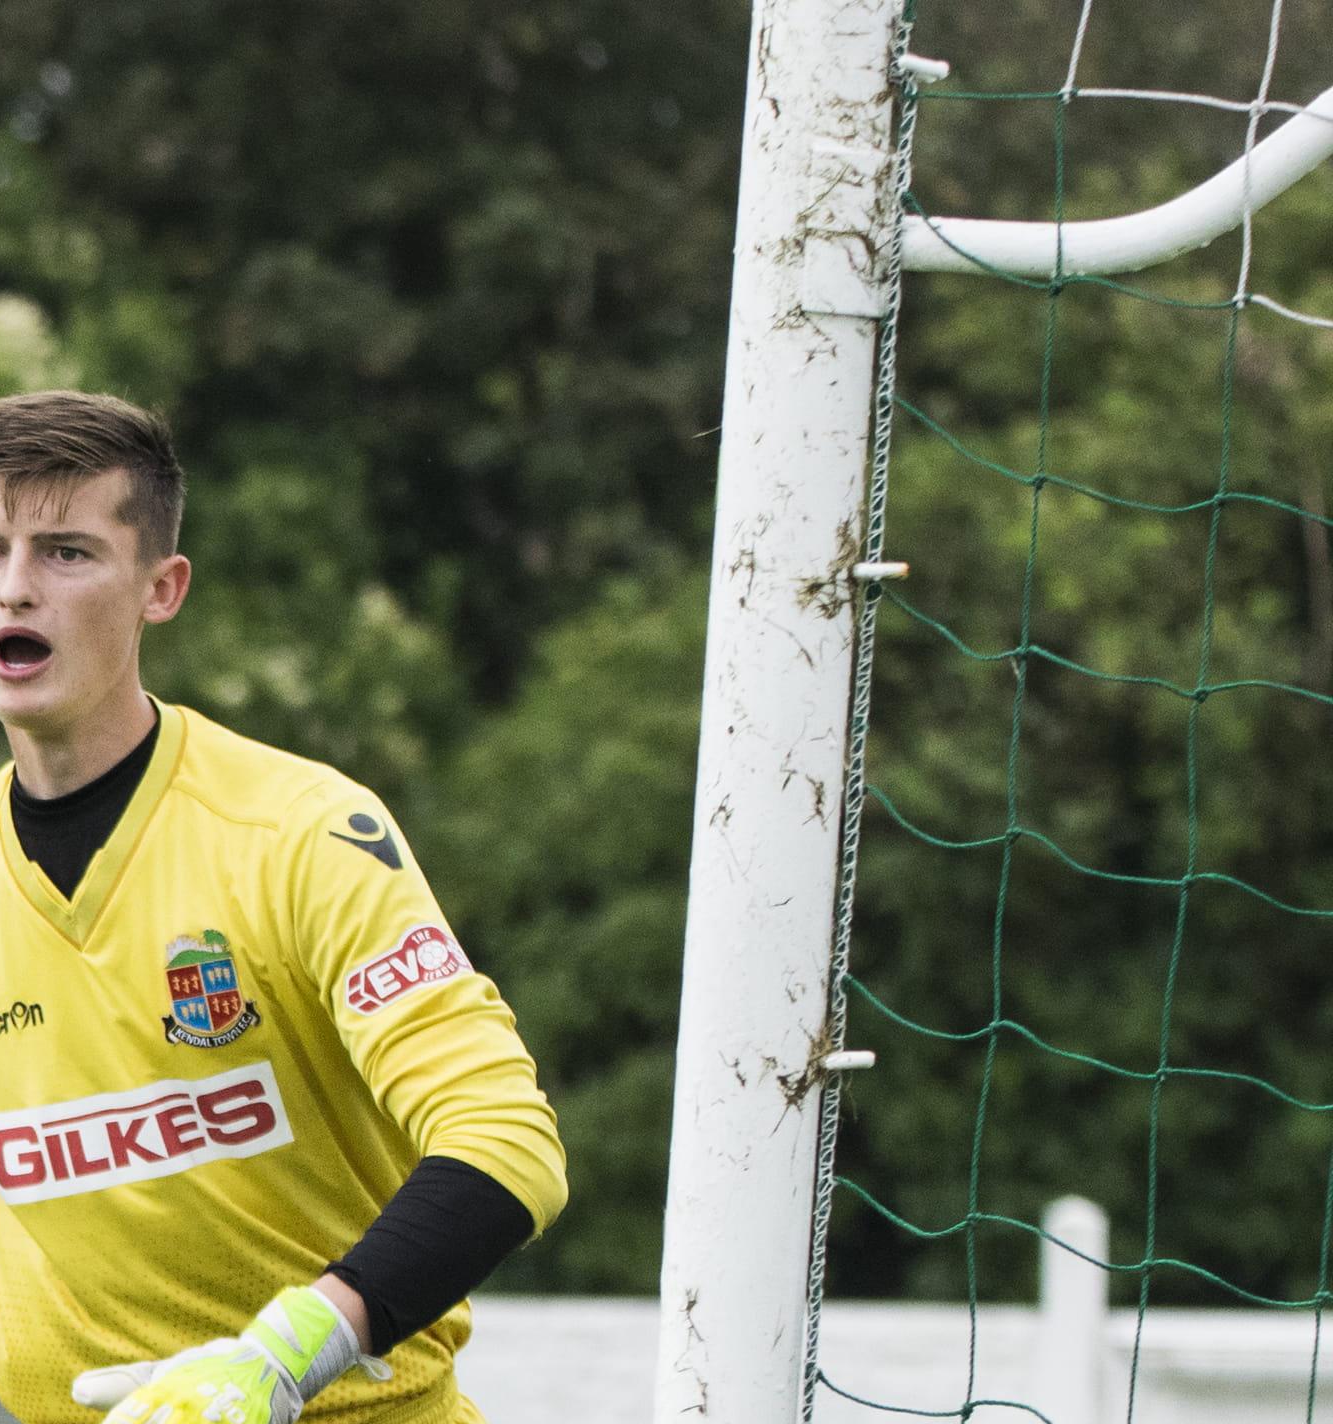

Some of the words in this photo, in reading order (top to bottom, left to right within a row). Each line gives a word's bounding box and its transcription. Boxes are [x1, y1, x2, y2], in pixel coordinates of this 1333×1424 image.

[412, 929, 432, 945] THE
[174, 1027, 213, 1048] KENDAL
[212, 1027, 242, 1047] TOWN
